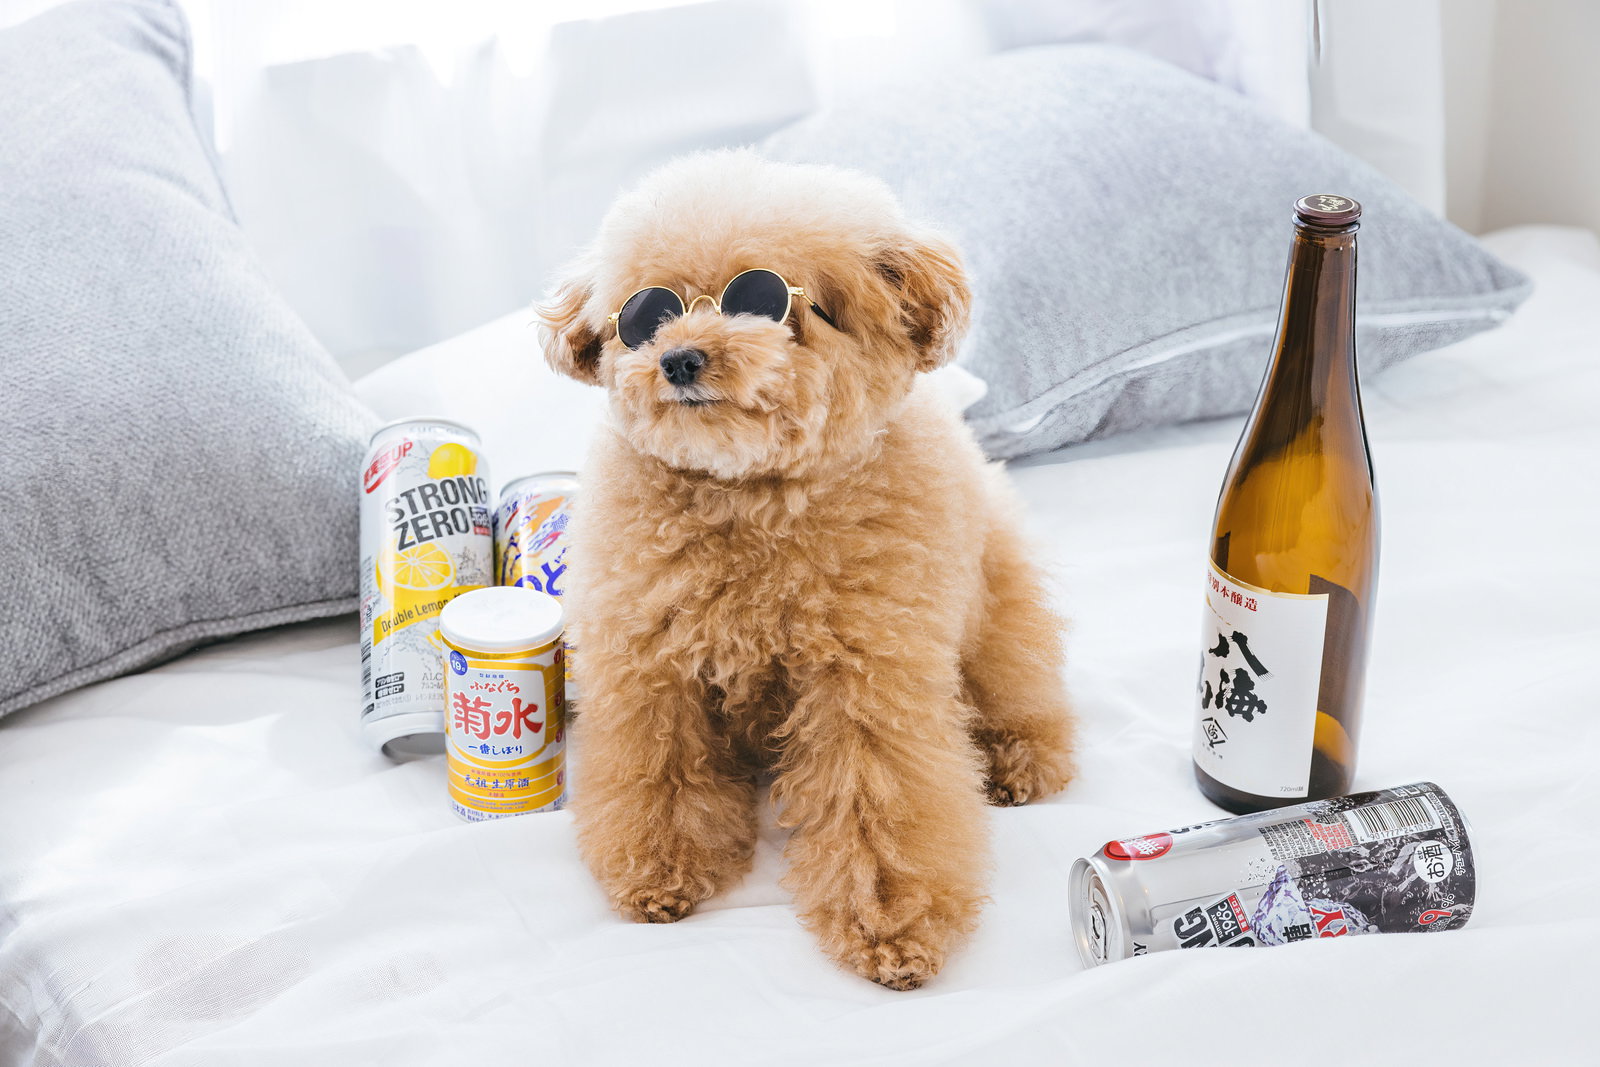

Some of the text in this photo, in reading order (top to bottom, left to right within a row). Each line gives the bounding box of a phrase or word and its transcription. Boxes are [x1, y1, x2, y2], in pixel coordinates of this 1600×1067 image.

[385, 476, 488, 523] STRONG
[393, 507, 469, 551] ZERO
[381, 608, 415, 633] Double
[470, 680, 520, 694] ふなぐち
[453, 692, 544, 740] 菊水
[468, 743, 523, 755] 一番しぼり
[464, 774, 530, 790] 元祖生原酒
[1423, 844, 1445, 879] お酒
[1211, 914, 1224, 939] SUNTORY
